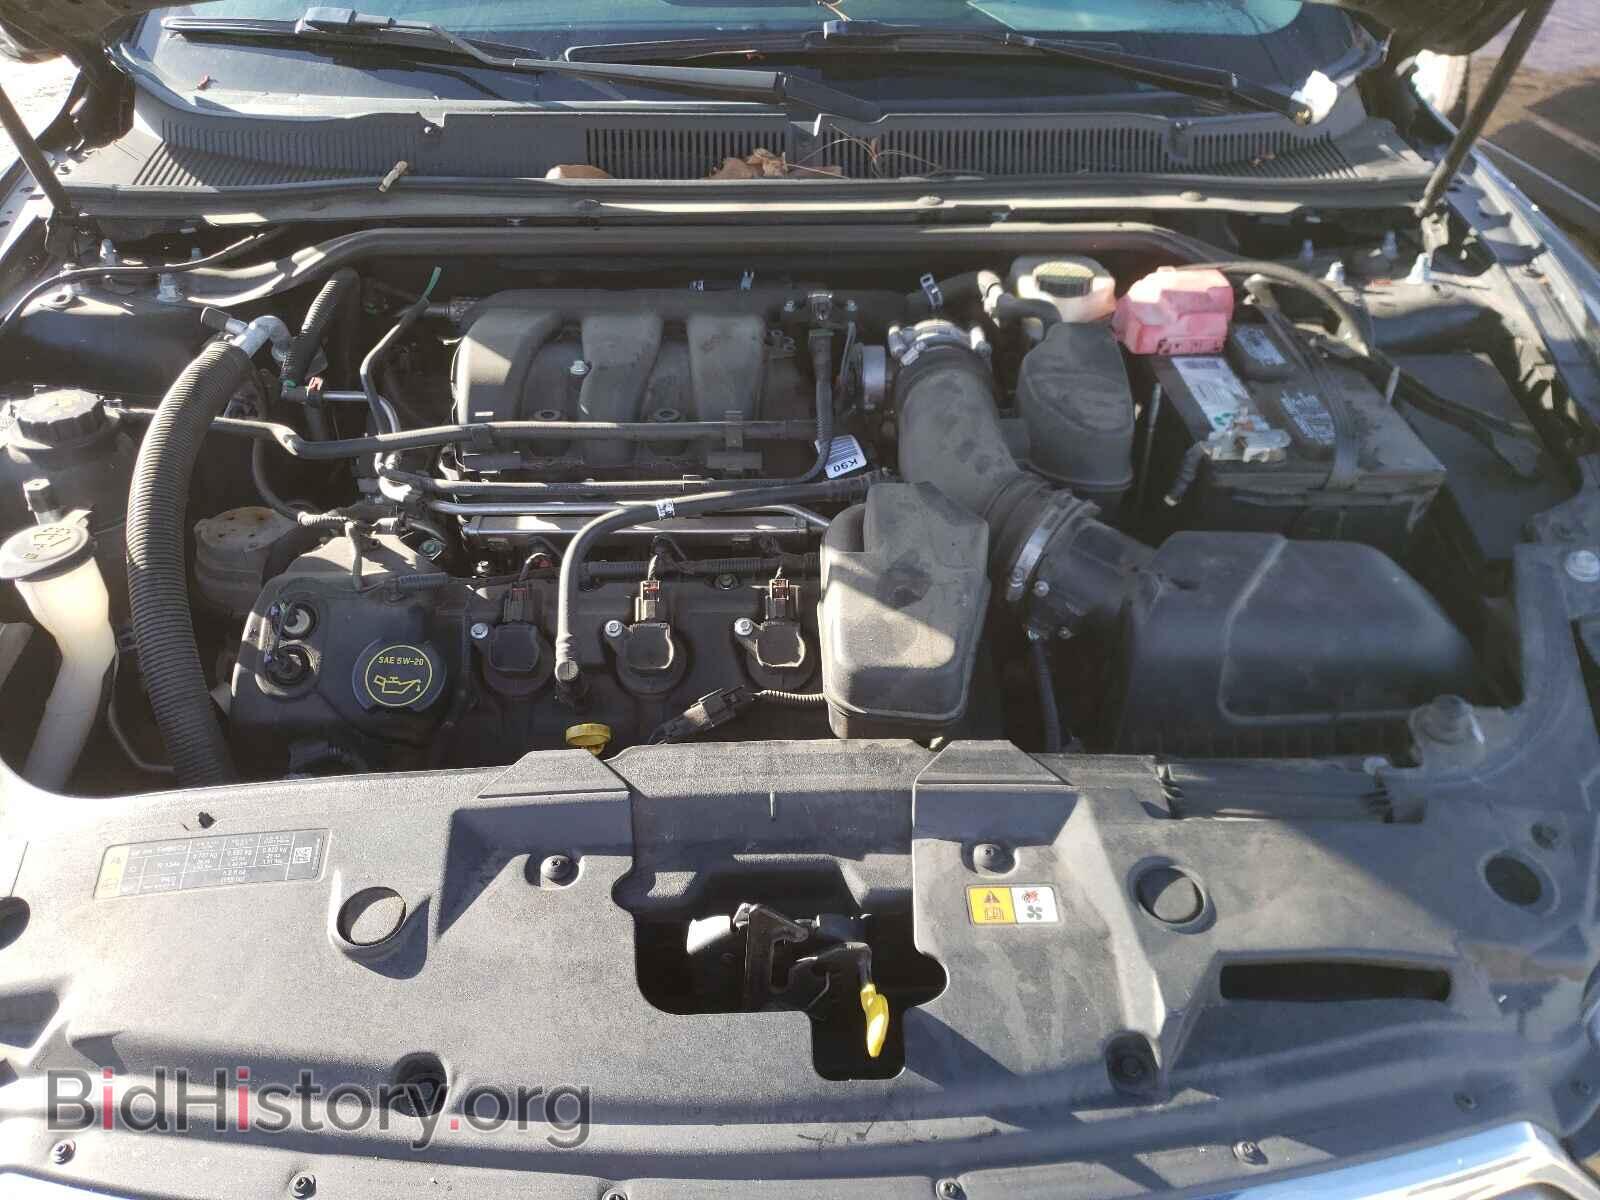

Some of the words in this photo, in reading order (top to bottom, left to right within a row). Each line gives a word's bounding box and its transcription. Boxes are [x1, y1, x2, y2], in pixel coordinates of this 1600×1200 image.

[833, 458, 858, 473] K90
[378, 656, 395, 665] SAE
[396, 656, 424, 666] 5W-20
